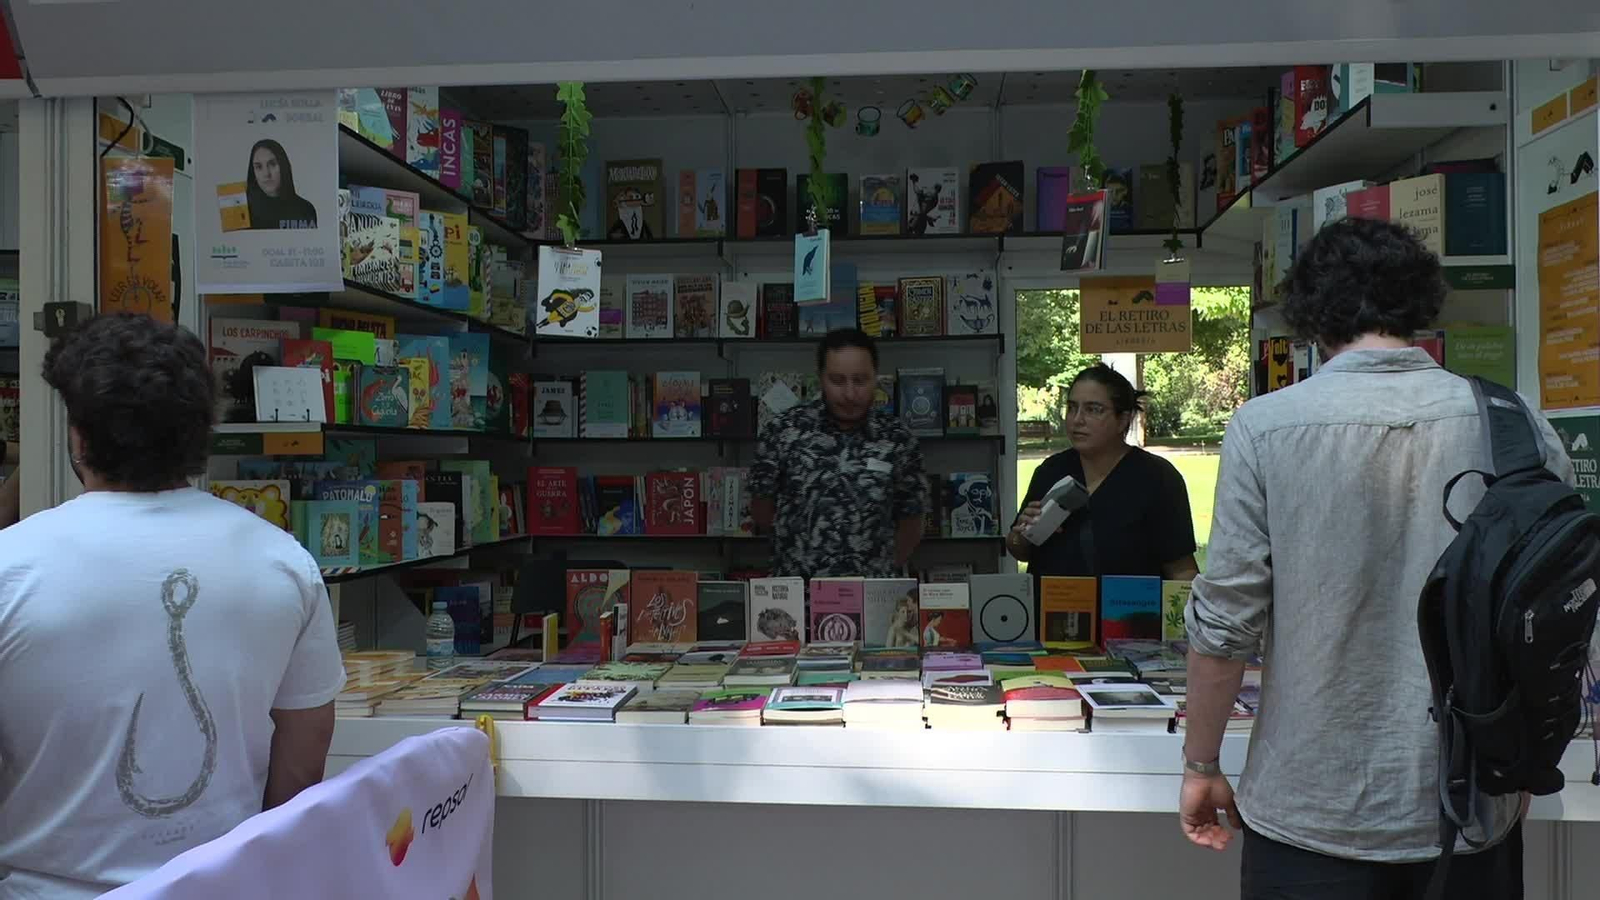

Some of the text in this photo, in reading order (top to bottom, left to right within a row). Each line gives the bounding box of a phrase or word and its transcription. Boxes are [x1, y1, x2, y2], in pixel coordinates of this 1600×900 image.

[443, 118, 456, 176] INCAS
[1399, 206, 1438, 222] lezama
[279, 219, 317, 230] FIRMA
[1100, 309, 1170, 323] EL RETIRO
[222, 326, 239, 338] LOS
[1086, 319, 1187, 335] DE LAS LETRAS
[541, 386, 567, 395] JAMES
[536, 479, 567, 488] EL ARTE
[535, 489, 568, 498] GUERRA
[421, 773, 474, 834] repsol
